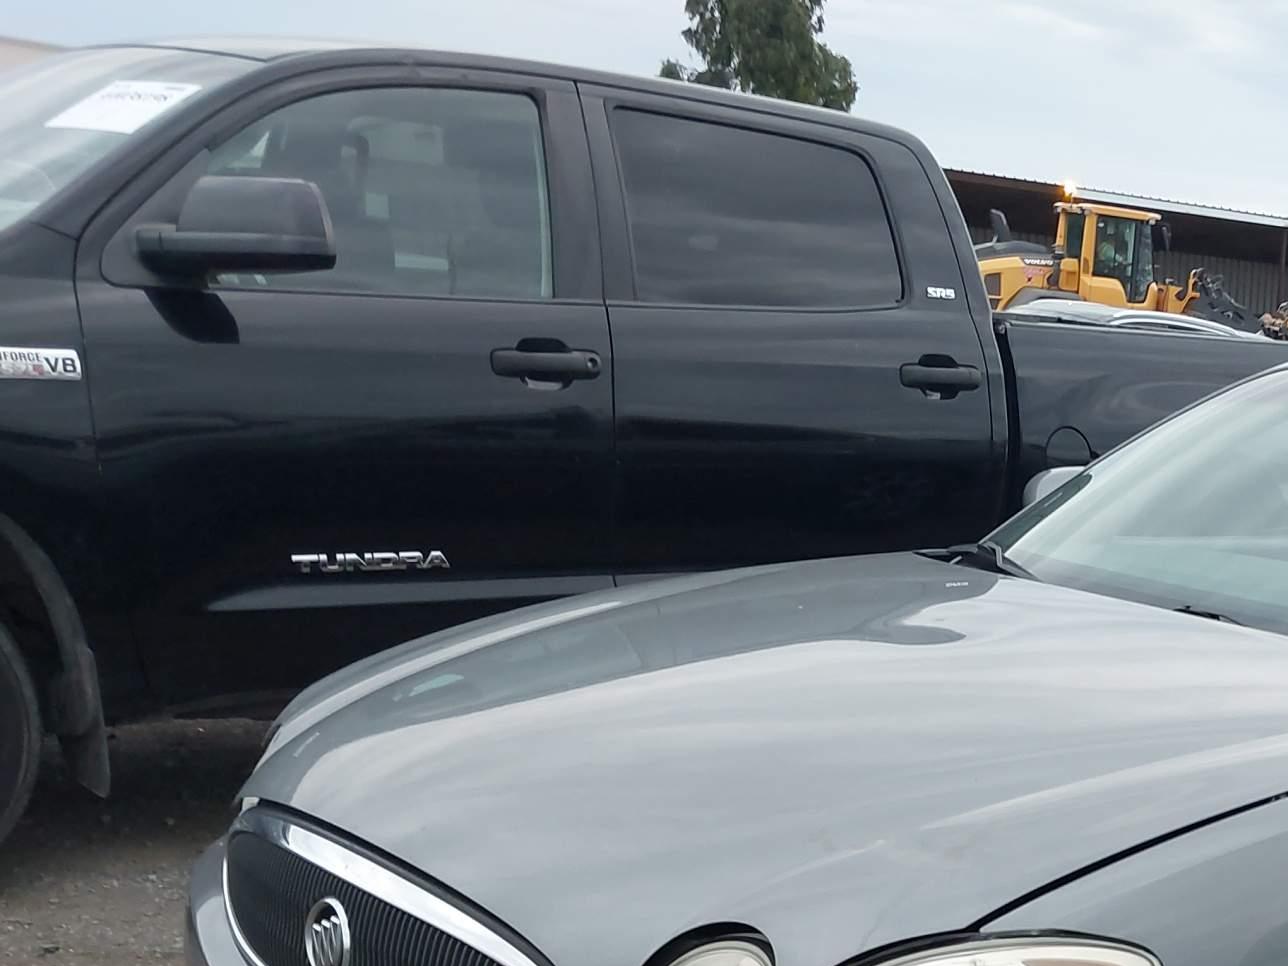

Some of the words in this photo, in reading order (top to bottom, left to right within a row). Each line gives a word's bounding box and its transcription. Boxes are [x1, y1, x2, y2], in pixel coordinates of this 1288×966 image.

[1023, 258, 1054, 267] VOLVO
[44, 357, 77, 373] V8
[290, 550, 450, 573] TUNDRA
